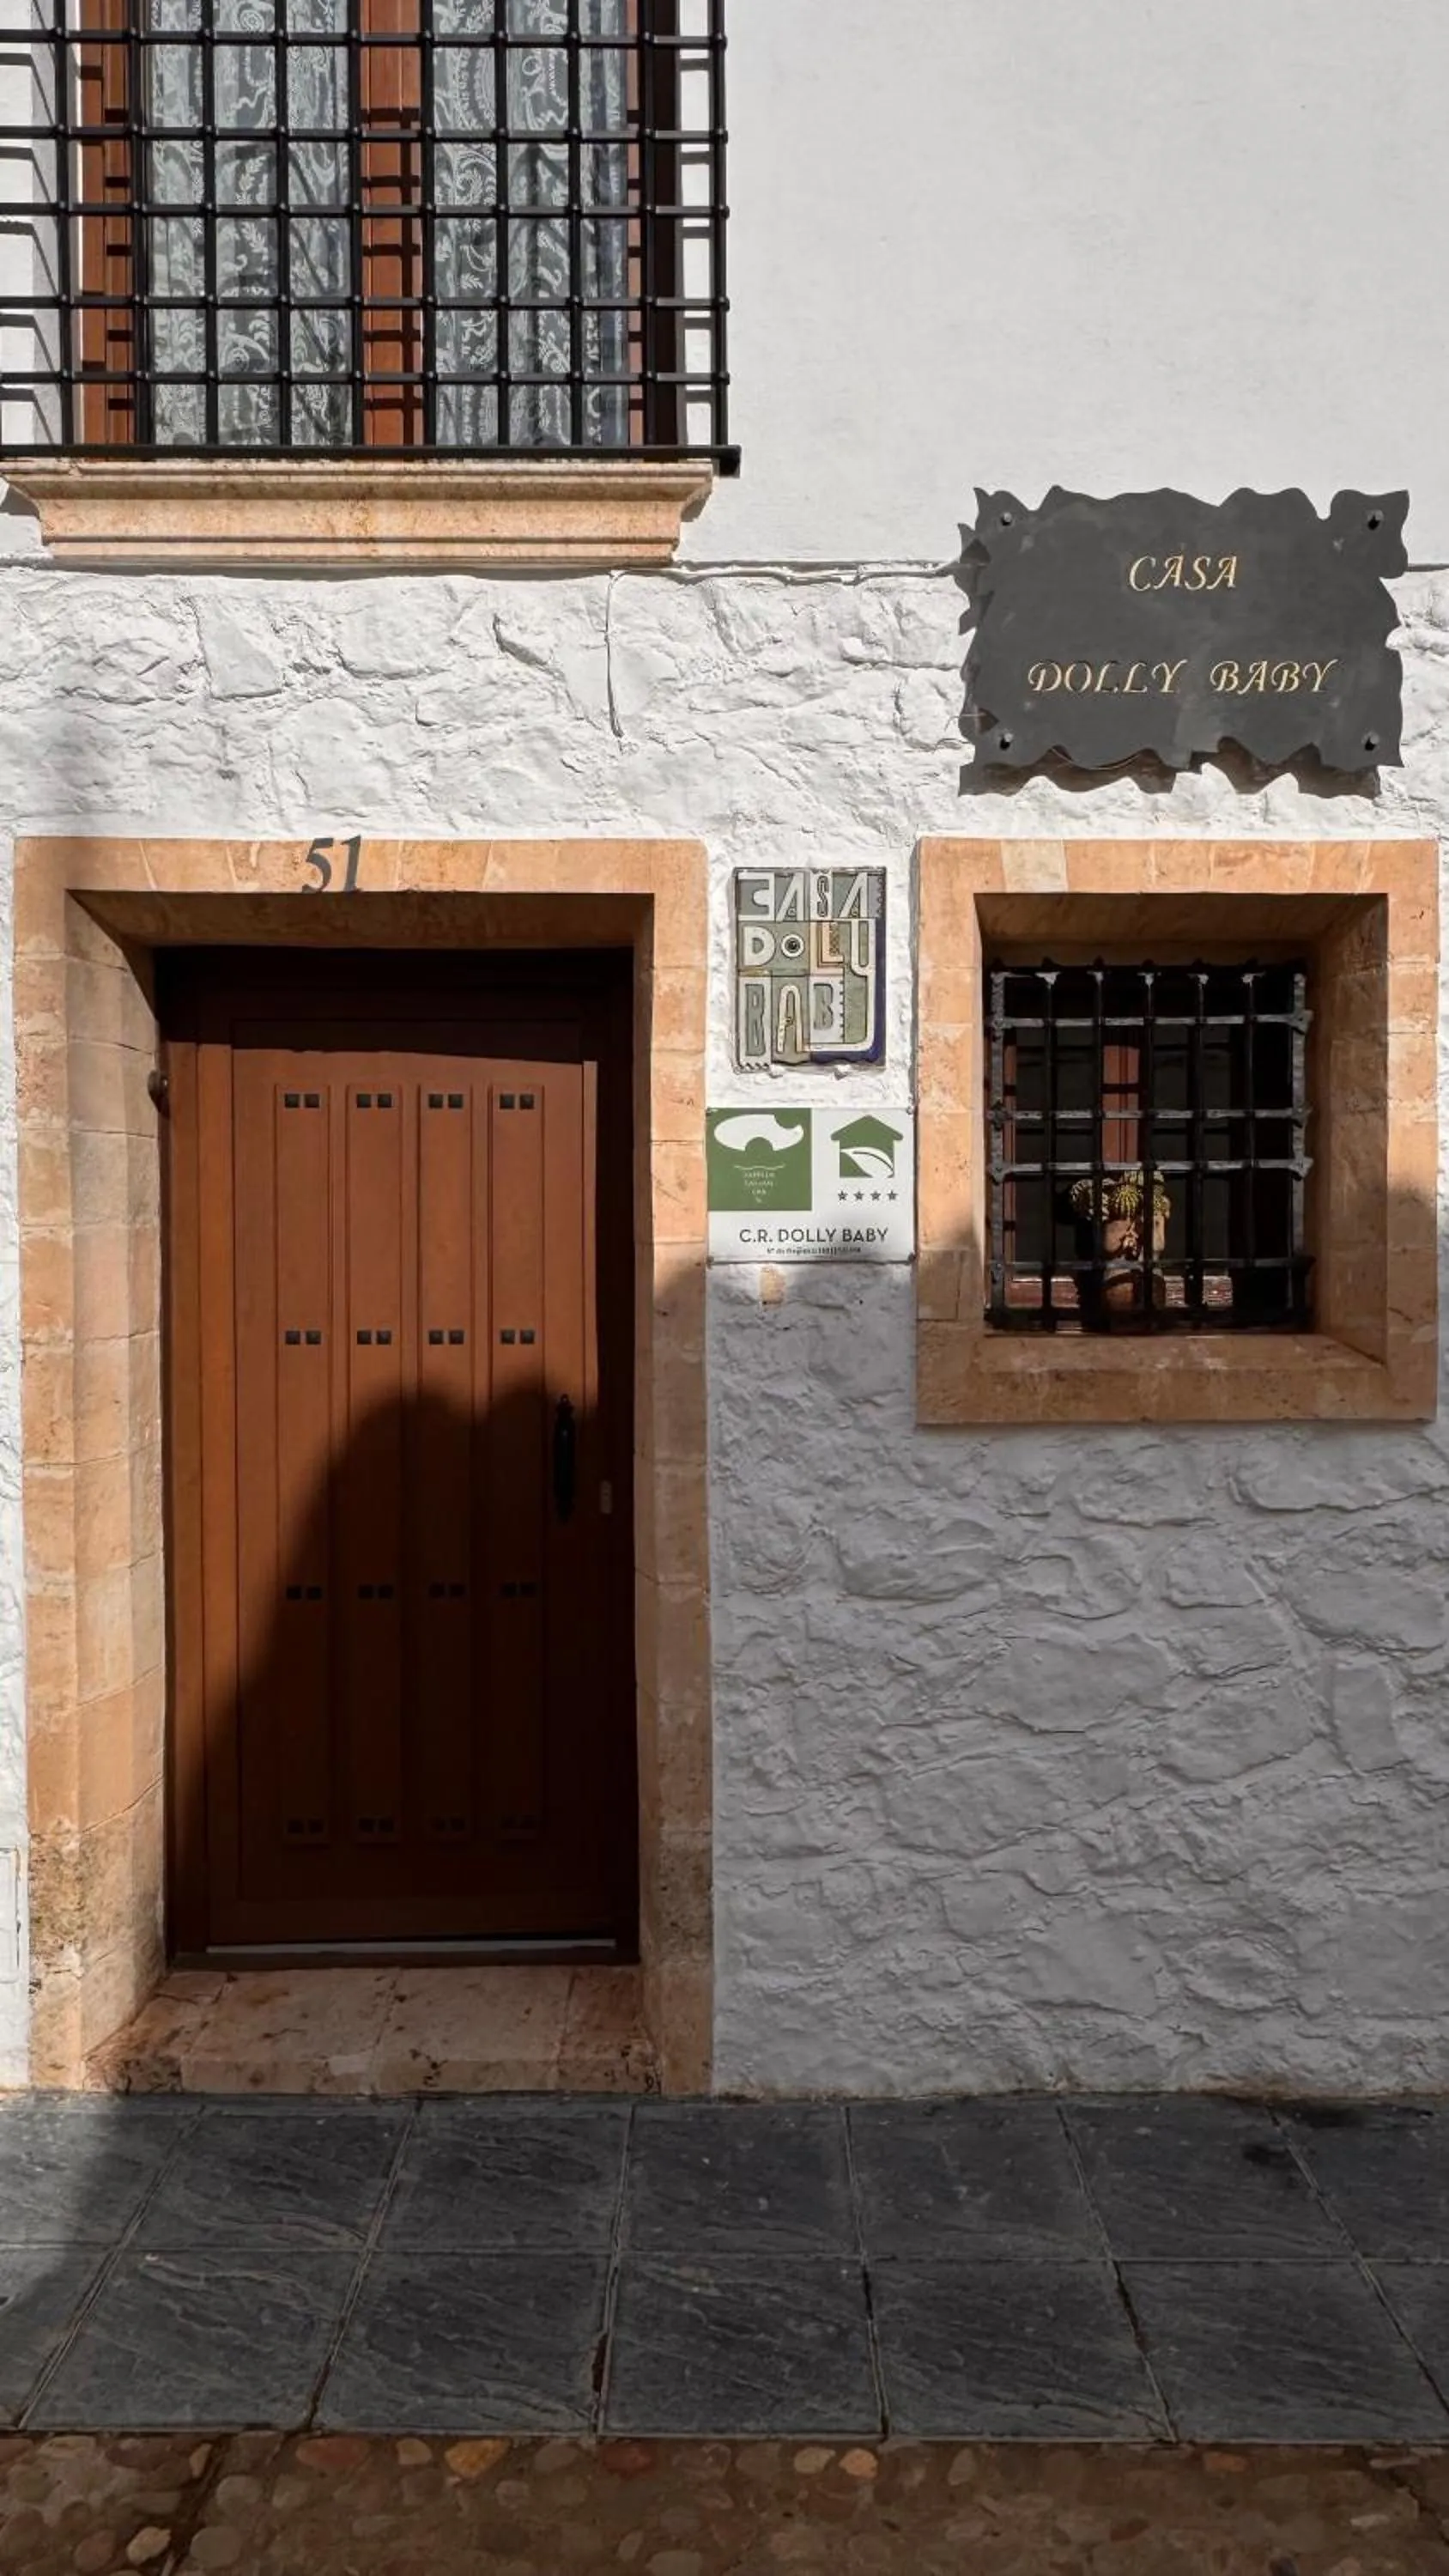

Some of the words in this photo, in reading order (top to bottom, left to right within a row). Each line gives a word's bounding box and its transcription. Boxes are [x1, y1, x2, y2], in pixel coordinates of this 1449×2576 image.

[1129, 555, 1237, 592] CASA
[1028, 659, 1187, 694] DOLLY
[1210, 659, 1338, 695] BABY
[300, 834, 362, 896] 51
[739, 1229, 773, 1242] C.R.
[778, 1229, 837, 1242] DOLLY
[842, 1228, 888, 1242] BABY
